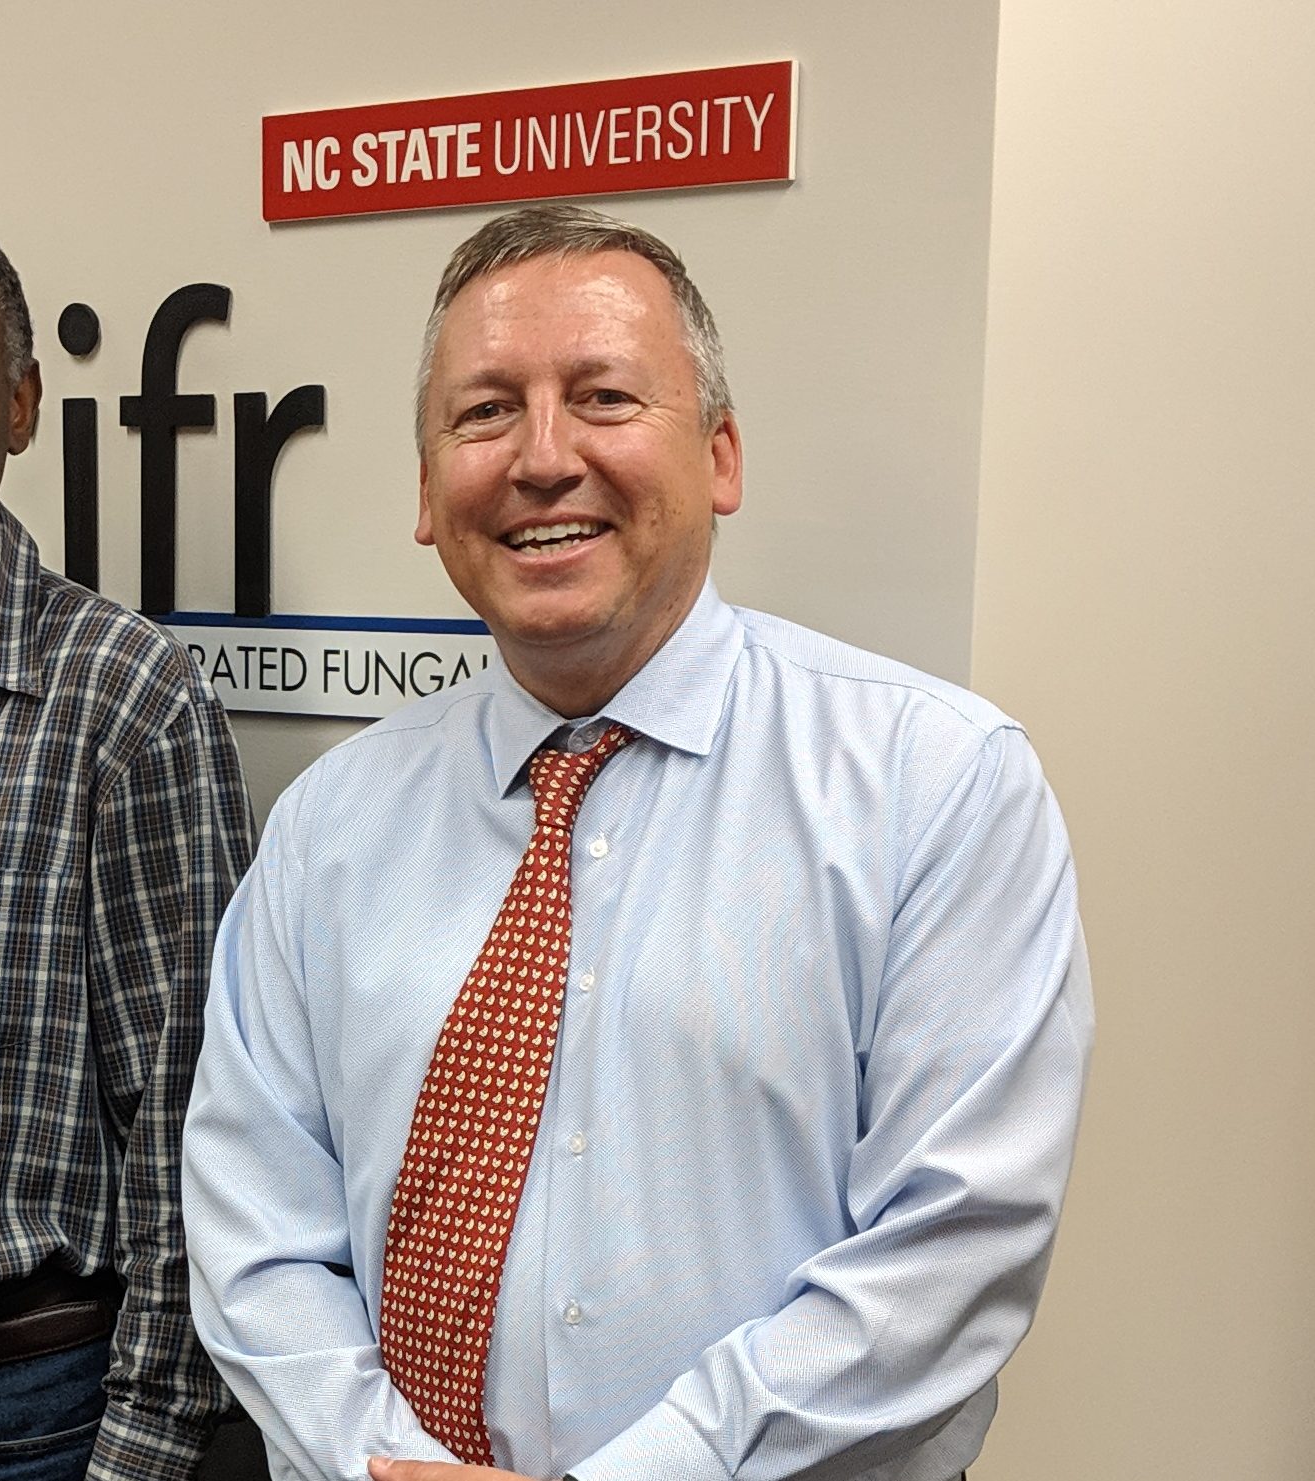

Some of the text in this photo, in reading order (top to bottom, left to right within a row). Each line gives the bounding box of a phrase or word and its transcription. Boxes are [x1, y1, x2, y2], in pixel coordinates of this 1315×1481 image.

[284, 93, 775, 193] NC STATE UNIVERSITY
